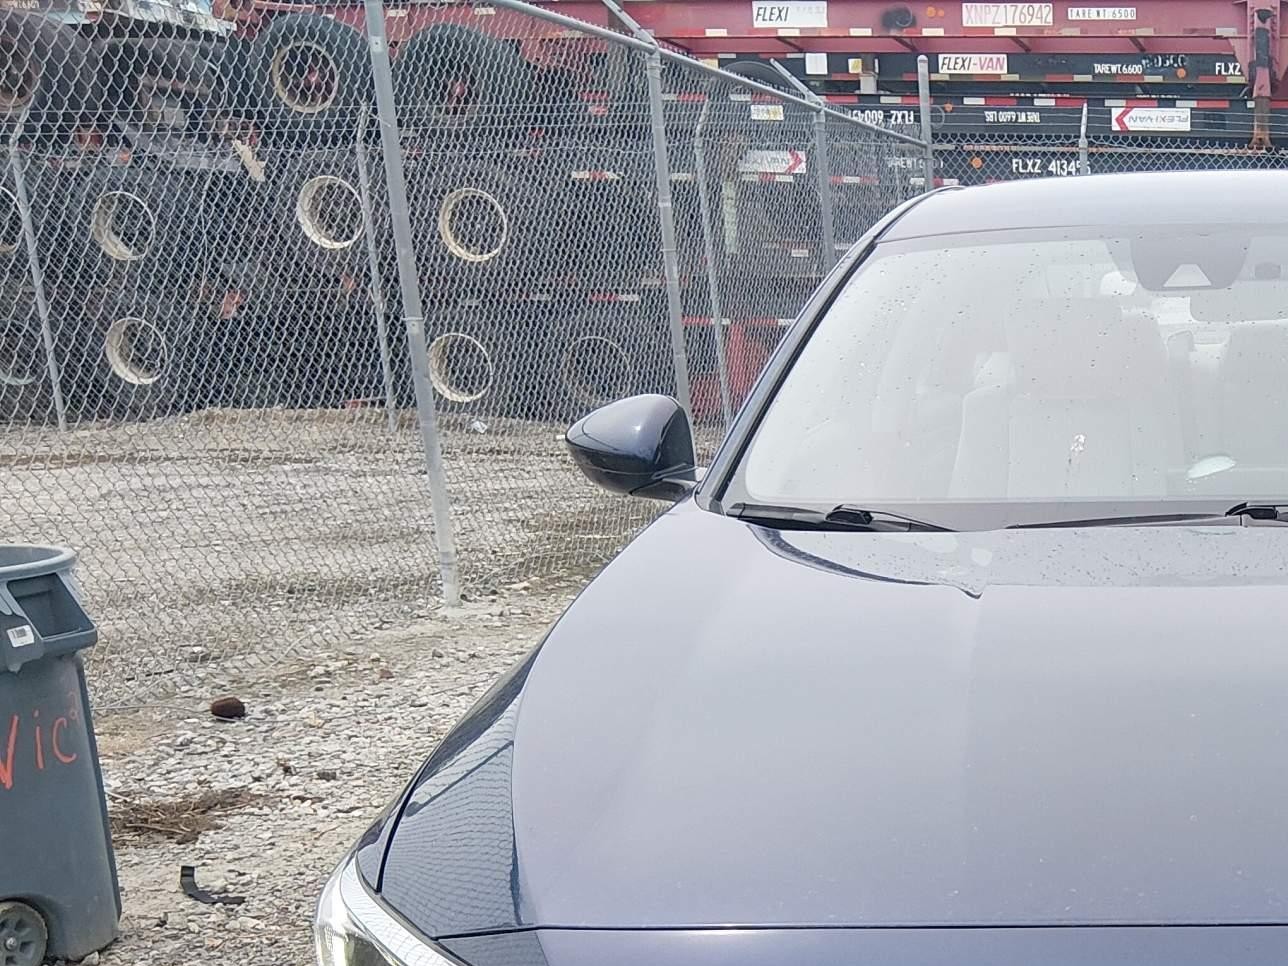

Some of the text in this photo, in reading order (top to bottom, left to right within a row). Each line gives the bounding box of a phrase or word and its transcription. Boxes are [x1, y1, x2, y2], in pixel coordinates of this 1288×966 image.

[755, 6, 790, 22] FLEXI
[1069, 9, 1093, 18] TARE
[1112, 9, 1135, 18] 6500
[940, 57, 1006, 71] FLEXI-VAN
[1215, 63, 1242, 75] FLXZ
[889, 110, 914, 124] FLXZ
[1012, 159, 1041, 173] FLXZ
